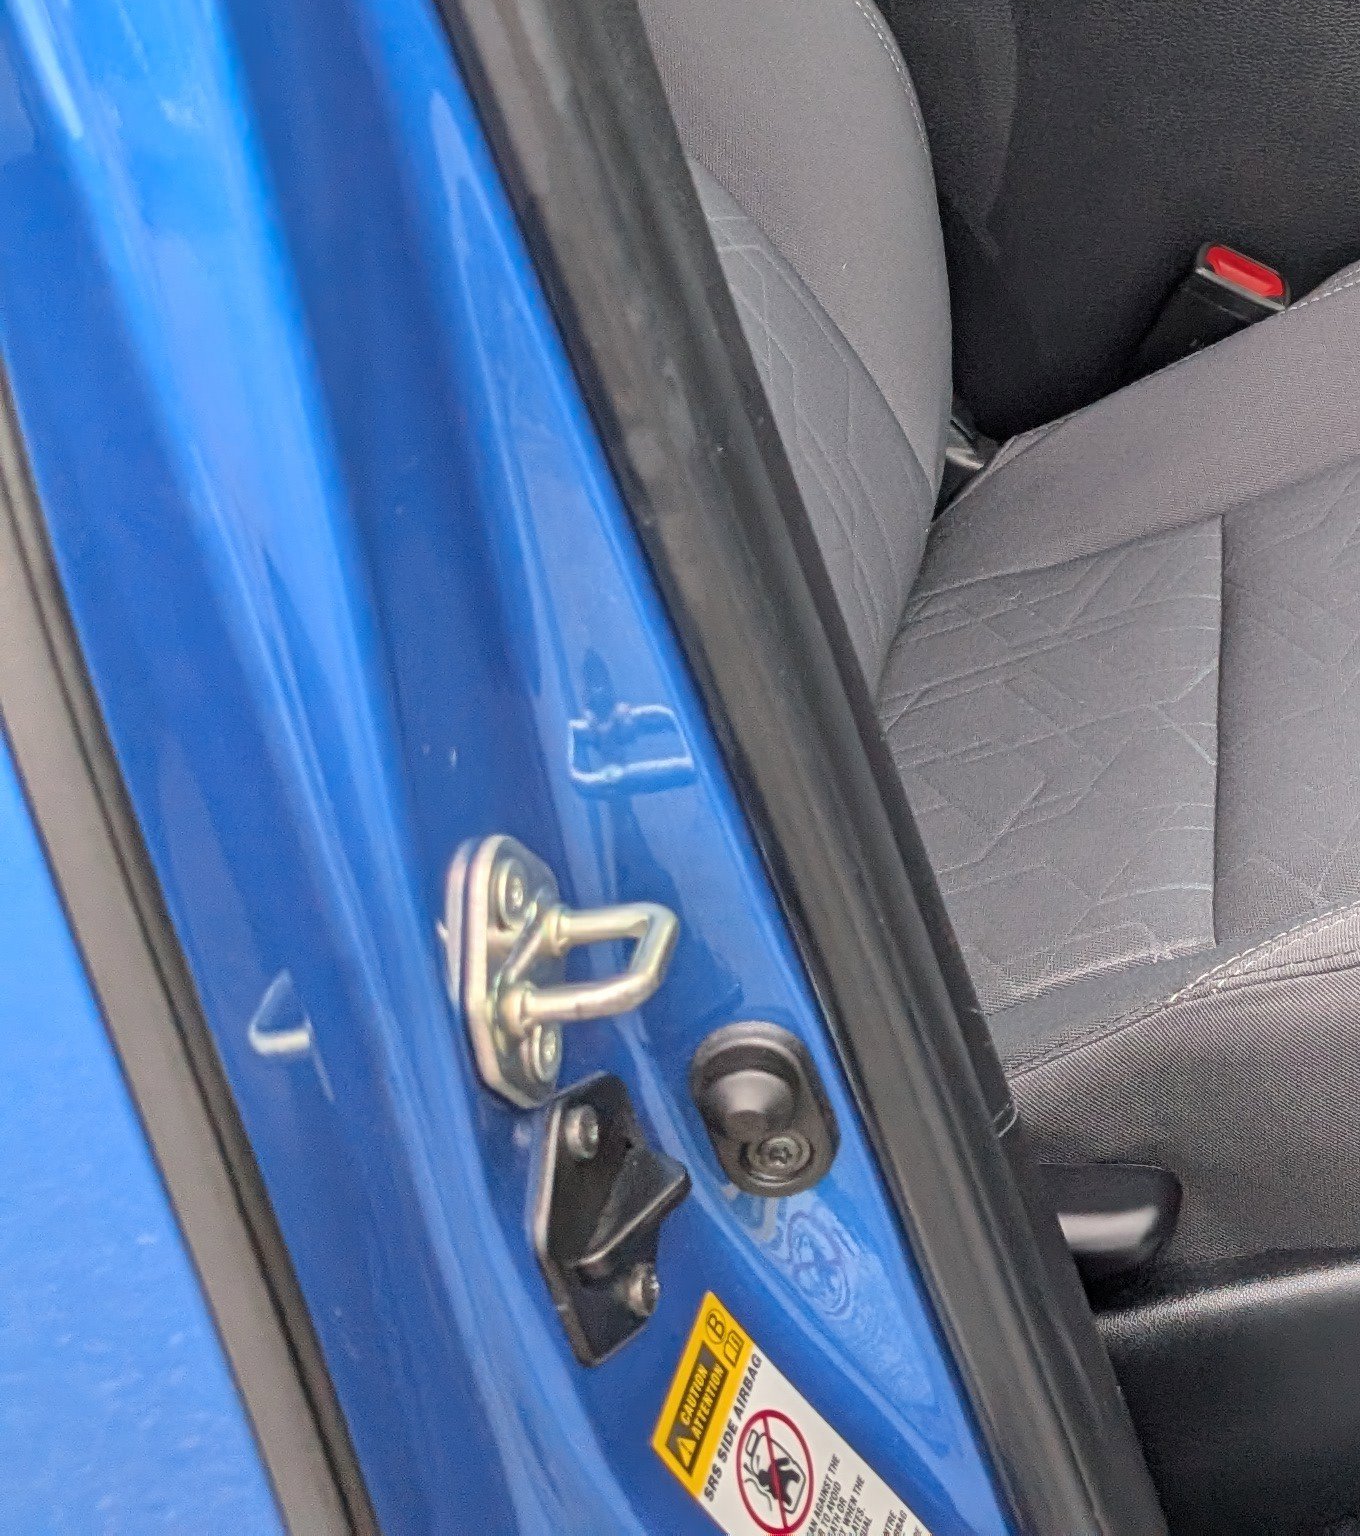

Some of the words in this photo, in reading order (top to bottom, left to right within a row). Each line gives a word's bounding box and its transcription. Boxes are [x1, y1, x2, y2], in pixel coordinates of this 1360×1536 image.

[679, 1363, 708, 1427] CAUTION
[690, 1362, 725, 1441] ATTENTION
[703, 1463, 723, 1503] SRS
[717, 1416, 739, 1464] SIDE
[733, 1353, 763, 1421] AIRBAG
[814, 1474, 834, 1519] AGAINST
[828, 1454, 841, 1475] THE
[826, 1481, 842, 1513] AVOID
[853, 1474, 866, 1496] THE
